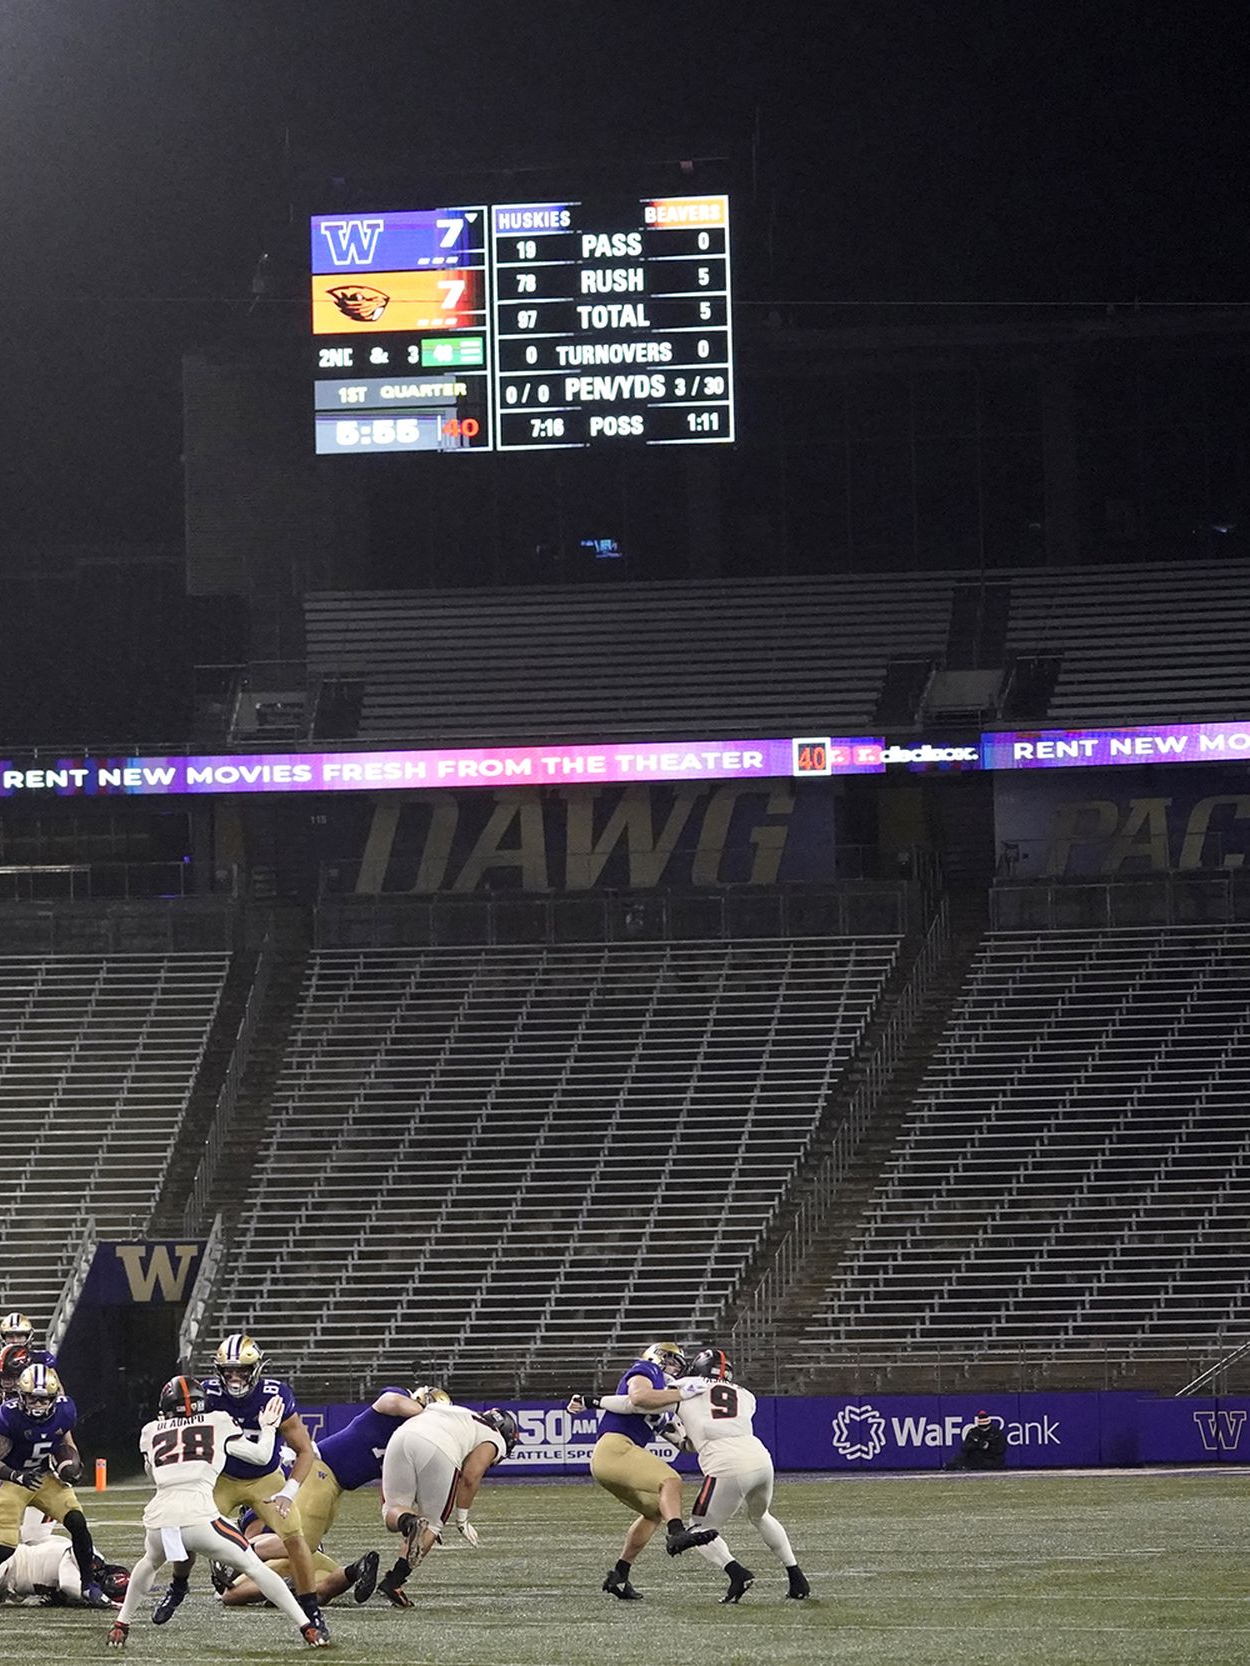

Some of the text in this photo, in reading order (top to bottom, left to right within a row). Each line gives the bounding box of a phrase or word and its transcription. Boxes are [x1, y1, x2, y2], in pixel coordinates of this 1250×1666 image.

[499, 210, 571, 229] HUSKIES
[645, 203, 721, 223] BEAVERS
[320, 219, 384, 265] W
[436, 218, 464, 248] 7
[581, 233, 643, 258] PASS
[698, 232, 710, 250] 0
[580, 268, 644, 294] RUSH
[698, 267, 710, 286] 5
[438, 280, 465, 309] 7
[577, 303, 651, 329] TOTAL
[700, 301, 712, 320] 5
[369, 346, 390, 364] &
[407, 345, 420, 363] 3
[525, 340, 710, 366] 0 TURNOVERS 0
[338, 382, 467, 403] 1ST QUARTER
[564, 374, 666, 401] PEN/YDS
[442, 418, 479, 438] 40
[590, 415, 645, 437] POSS
[687, 412, 720, 432] 1:11
[797, 745, 827, 771] 40
[1013, 739, 1099, 760] RENT
[1110, 735, 1189, 757] NEW
[2, 751, 764, 789] RENT NEW MOVIES FRESH FROM THE THEATER
[354, 783, 796, 893] DAWG
[114, 1244, 198, 1302] W
[709, 1383, 739, 1421] 9
[572, 1420, 597, 1435] AM
[1193, 1410, 1247, 1450] W
[23, 1441, 53, 1468] 5
[151, 1425, 216, 1468] 28
[506, 1450, 563, 1460] EATTLE
